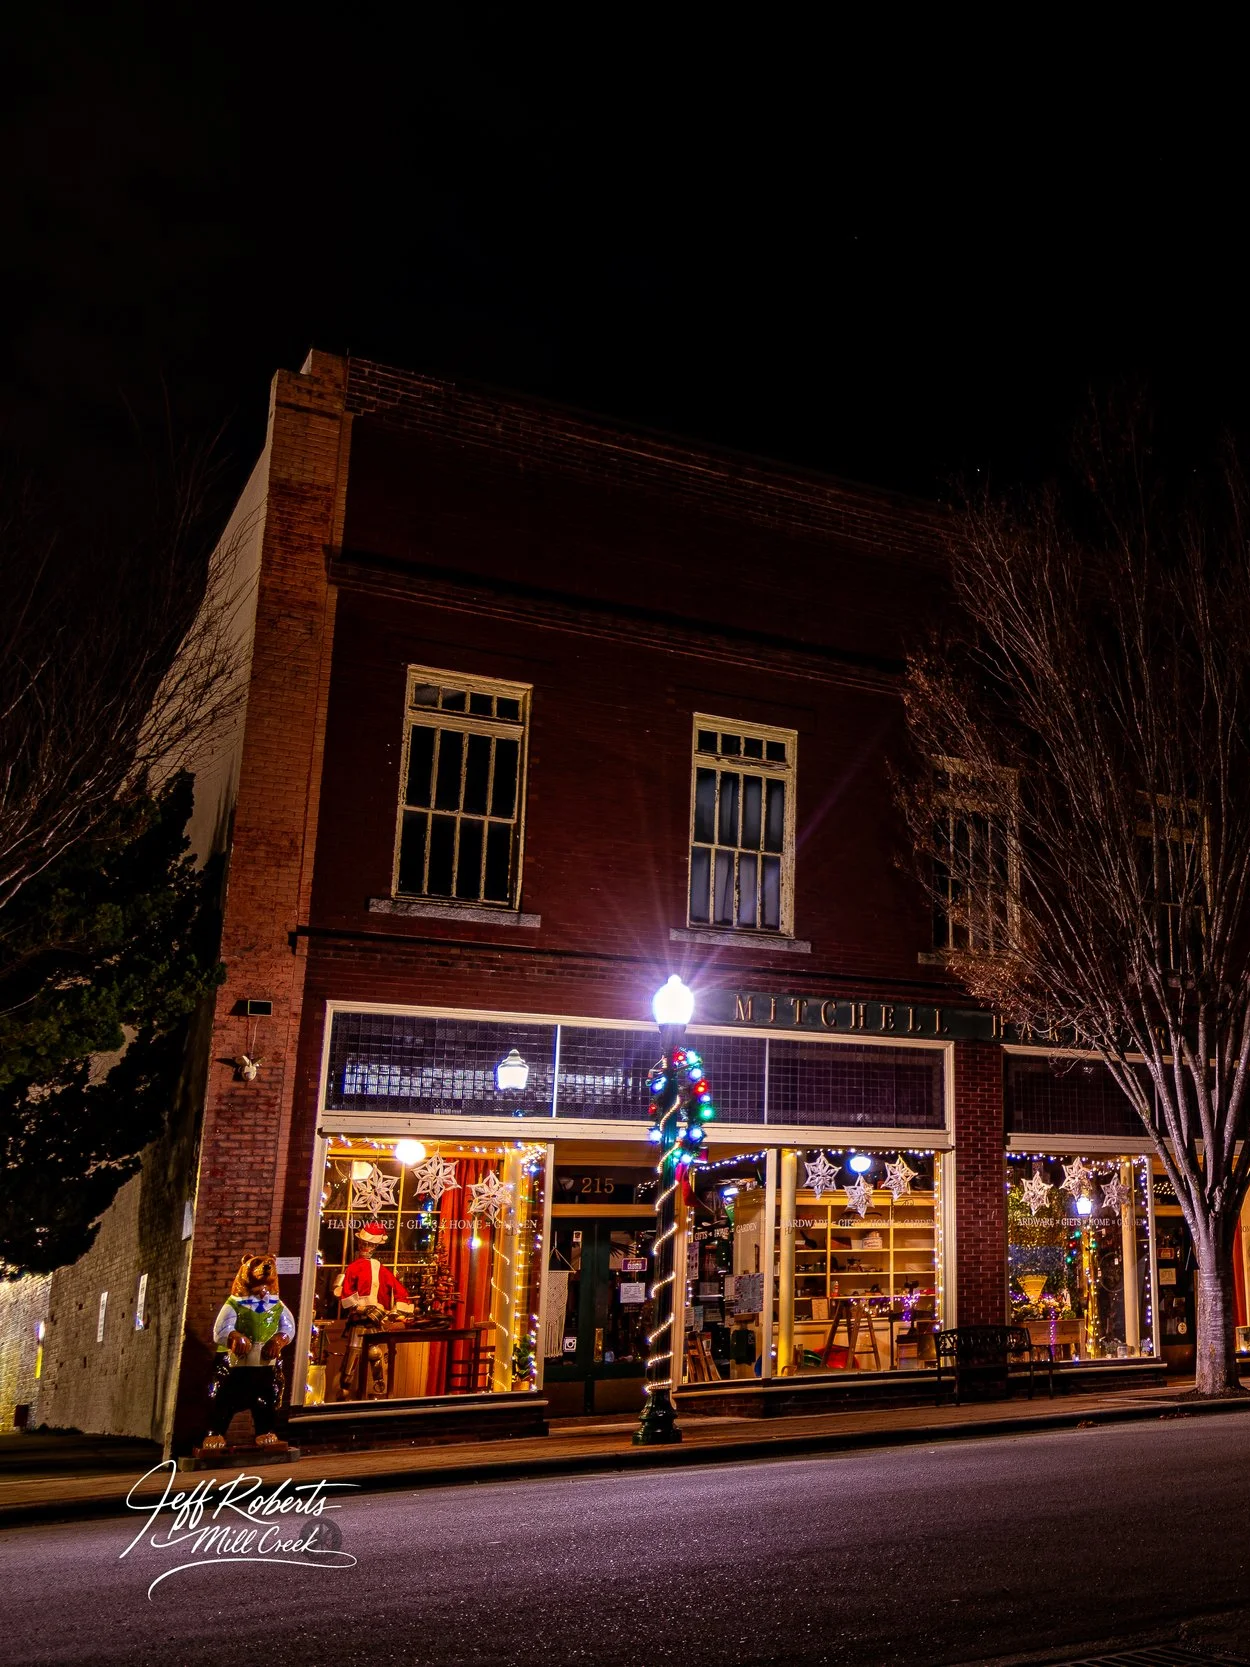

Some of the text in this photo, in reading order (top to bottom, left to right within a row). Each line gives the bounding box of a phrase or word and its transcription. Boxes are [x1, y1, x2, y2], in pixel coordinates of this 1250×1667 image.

[734, 993, 951, 1035] MITCHELL
[580, 1177, 615, 1195] 215
[327, 1219, 395, 1230] HARDWARE
[406, 1219, 438, 1230] GIFS
[449, 1219, 483, 1230] HOME
[1017, 1216, 1055, 1227] ARDWARE
[1061, 1217, 1082, 1227] GIFTS
[1088, 1217, 1111, 1227] HOME
[735, 1222, 758, 1234] GARDEN
